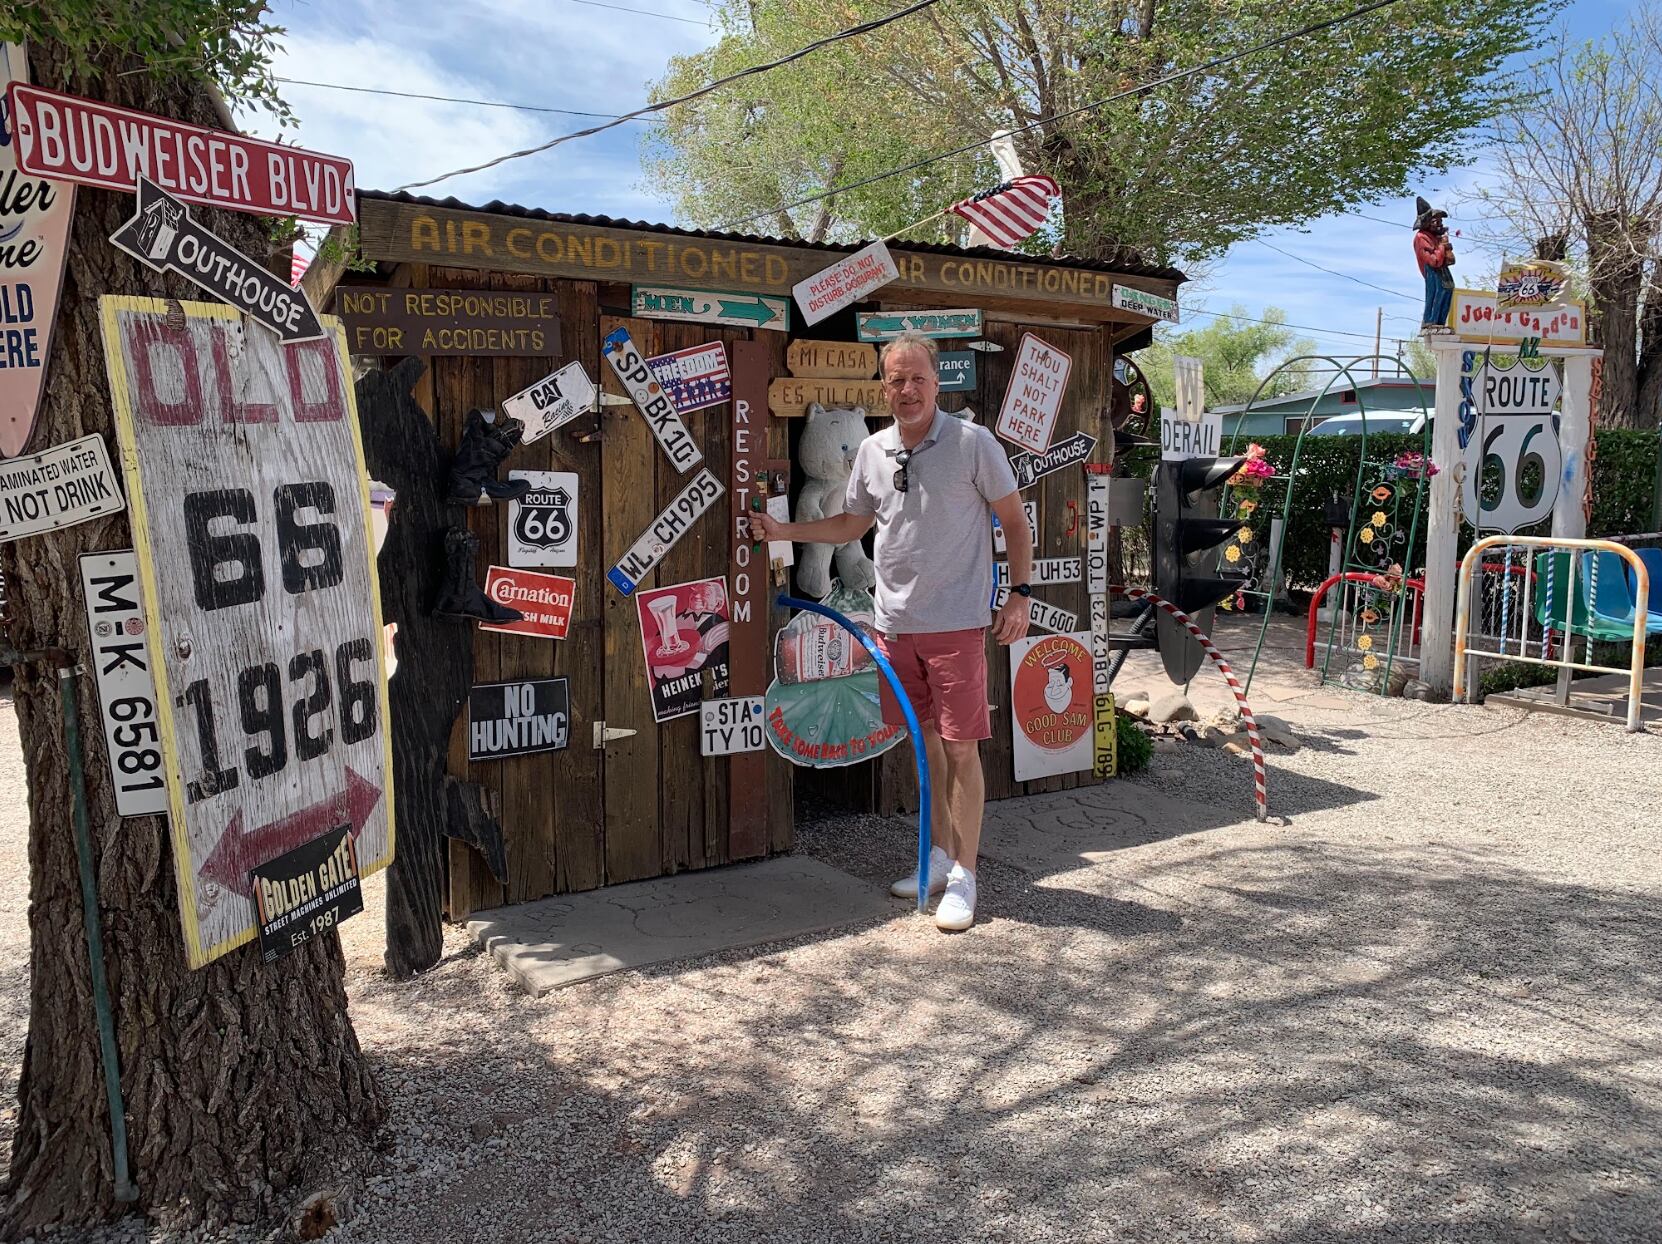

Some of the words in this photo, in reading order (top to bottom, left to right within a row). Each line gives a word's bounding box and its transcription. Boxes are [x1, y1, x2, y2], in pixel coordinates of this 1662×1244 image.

[35, 101, 252, 201] BUDWEISER
[268, 156, 342, 215] BLVD
[411, 215, 493, 256] AIR
[506, 227, 788, 286] CONDITIONED
[178, 234, 304, 333] OUTHOUSE
[809, 272, 842, 296] PLEASE
[842, 265, 856, 279] DO
[857, 254, 875, 270] NOT
[899, 255, 926, 283] IR
[940, 262, 1109, 299] CONDITIONED
[1521, 284, 1536, 296] 66
[0, 284, 34, 324] LD
[344, 292, 392, 315] NOT
[405, 294, 553, 319] RESPONSIBLE
[644, 293, 711, 313] MEN
[808, 287, 844, 312] DISTURB
[1121, 300, 1143, 310] DEEP
[1147, 306, 1172, 319] WATER
[906, 314, 978, 329] WOMEN
[1520, 312, 1579, 338] Garden
[356, 326, 404, 350] FOR
[422, 327, 545, 350] ACCIDENTS
[1519, 337, 1541, 359] AZ
[133, 320, 343, 427] OLD
[654, 352, 719, 383] FREEDOM
[800, 349, 817, 367] MI
[827, 351, 867, 369] CASA
[939, 360, 971, 371] rance
[1031, 346, 1061, 374] THOU
[616, 352, 648, 384] SP
[644, 396, 677, 434] BK
[1020, 363, 1060, 392] SHALT
[1486, 376, 1550, 408] ROUTE
[530, 378, 563, 410] CAT
[783, 386, 804, 405] ES
[845, 388, 886, 406] CASA
[1023, 384, 1047, 406] NOT
[1013, 398, 1047, 426] PARK
[1008, 416, 1041, 442] HERE
[1163, 418, 1217, 455] DERAIL
[60, 450, 98, 475] WATER
[1033, 438, 1088, 472] OUTHOUSE
[1474, 424, 1545, 512] 66
[5, 489, 50, 523] NOT
[54, 470, 112, 511] DRINK
[525, 494, 562, 505] ROUTE
[733, 400, 751, 623] RESTROOM
[524, 509, 565, 540] 66
[184, 481, 344, 611] 66
[620, 551, 654, 580] WL
[1040, 561, 1060, 581] UH
[1063, 560, 1081, 579] 53
[491, 577, 569, 608] Carnation
[539, 613, 565, 627] MILK
[1030, 602, 1048, 624] GT
[1049, 610, 1074, 633] 600
[817, 627, 827, 678] Budweiser
[1025, 639, 1086, 667] WELCOME
[661, 663, 728, 699] HEINEK'S
[504, 683, 535, 718] NO
[719, 701, 752, 725] STA
[175, 638, 377, 803] 1926
[471, 712, 566, 753] HUNTING
[769, 706, 793, 746] TAKE
[821, 742, 849, 760] BACK
[850, 736, 865, 755] TO
[1026, 713, 1057, 734] GOOD
[1062, 712, 1087, 727] SAM
[109, 696, 164, 792] 6581
[705, 727, 734, 752] TY
[741, 725, 762, 749] 10
[1043, 730, 1073, 745] CLUB
[261, 871, 317, 922] GOLDEN
[319, 834, 353, 892] GATE
[265, 915, 289, 936] STREET
[291, 897, 323, 920] MACHINES
[325, 879, 357, 902] UNLIMITED
[291, 930, 309, 947] Est.
[310, 906, 340, 935] 1987
